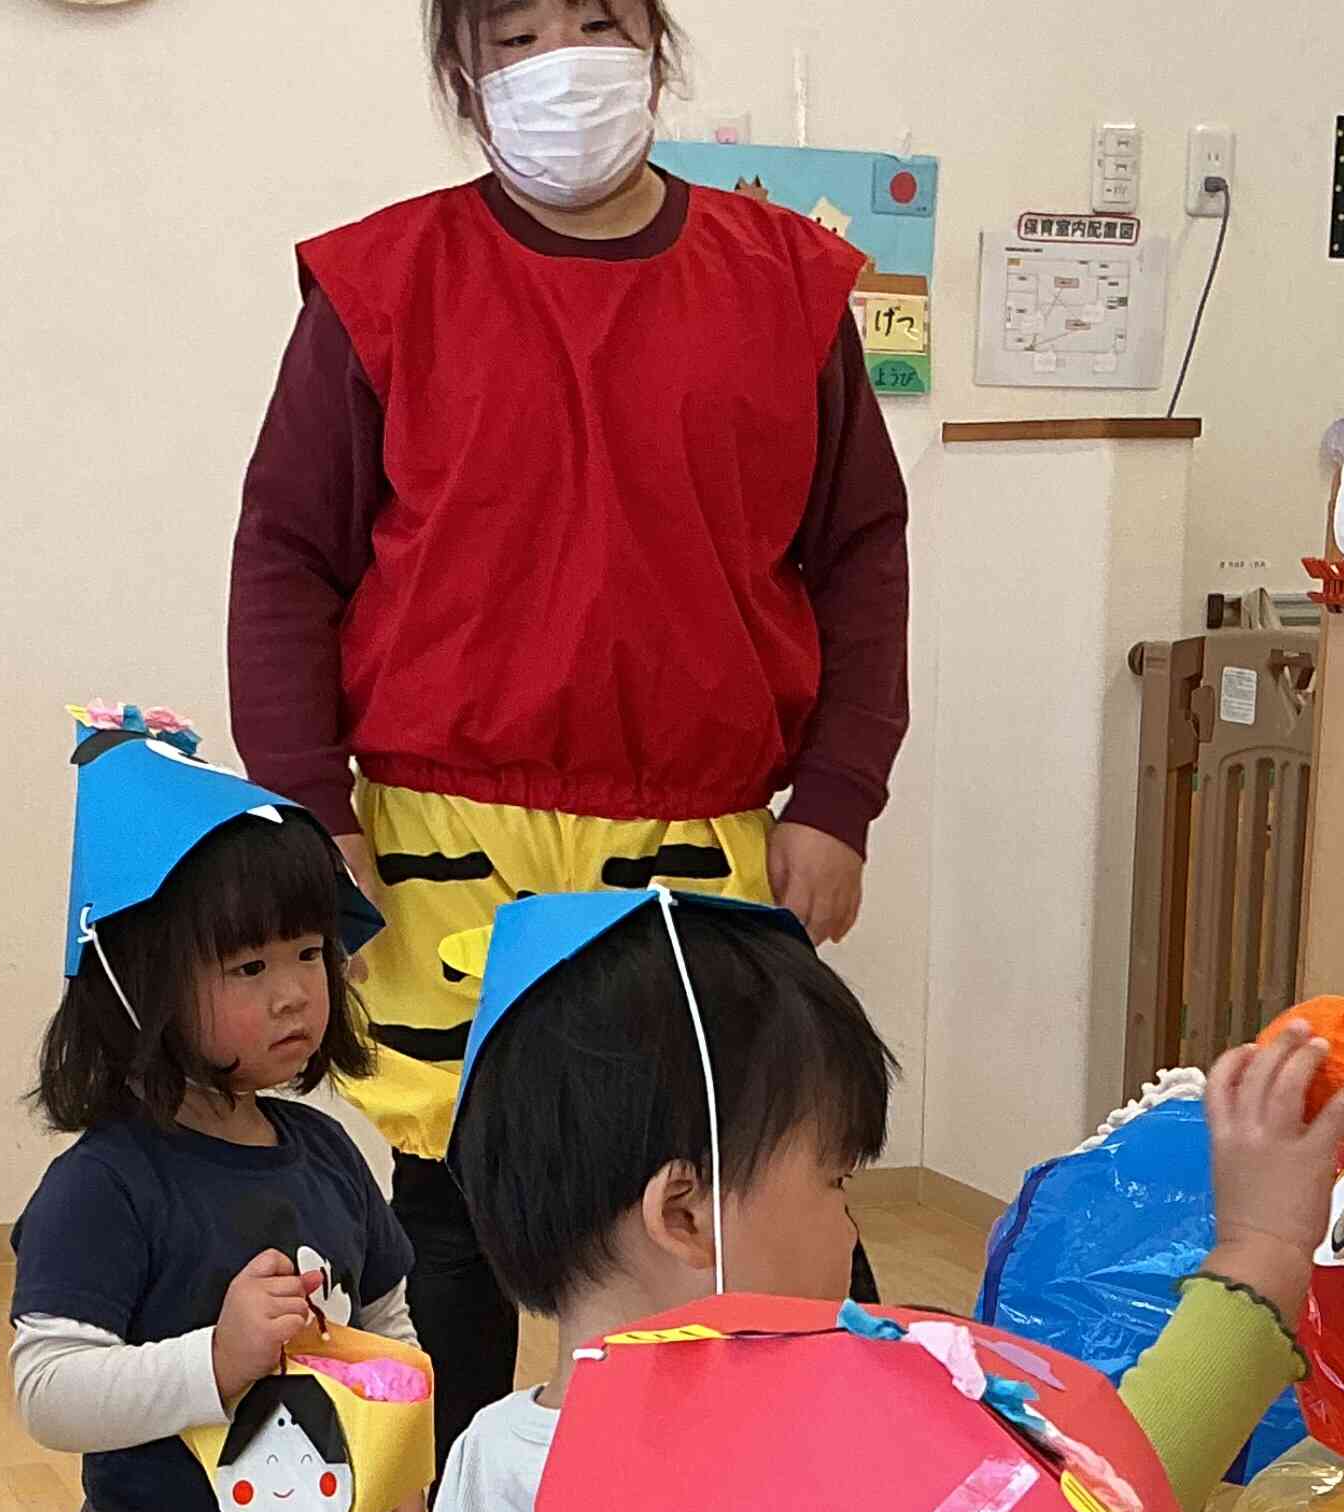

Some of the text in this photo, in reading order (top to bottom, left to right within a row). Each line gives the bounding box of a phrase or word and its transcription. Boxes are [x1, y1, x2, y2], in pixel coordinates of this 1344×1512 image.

[1024, 218, 1135, 240] 保育室内配置図
[875, 306, 915, 336] げつ
[875, 367, 917, 386] ようび
